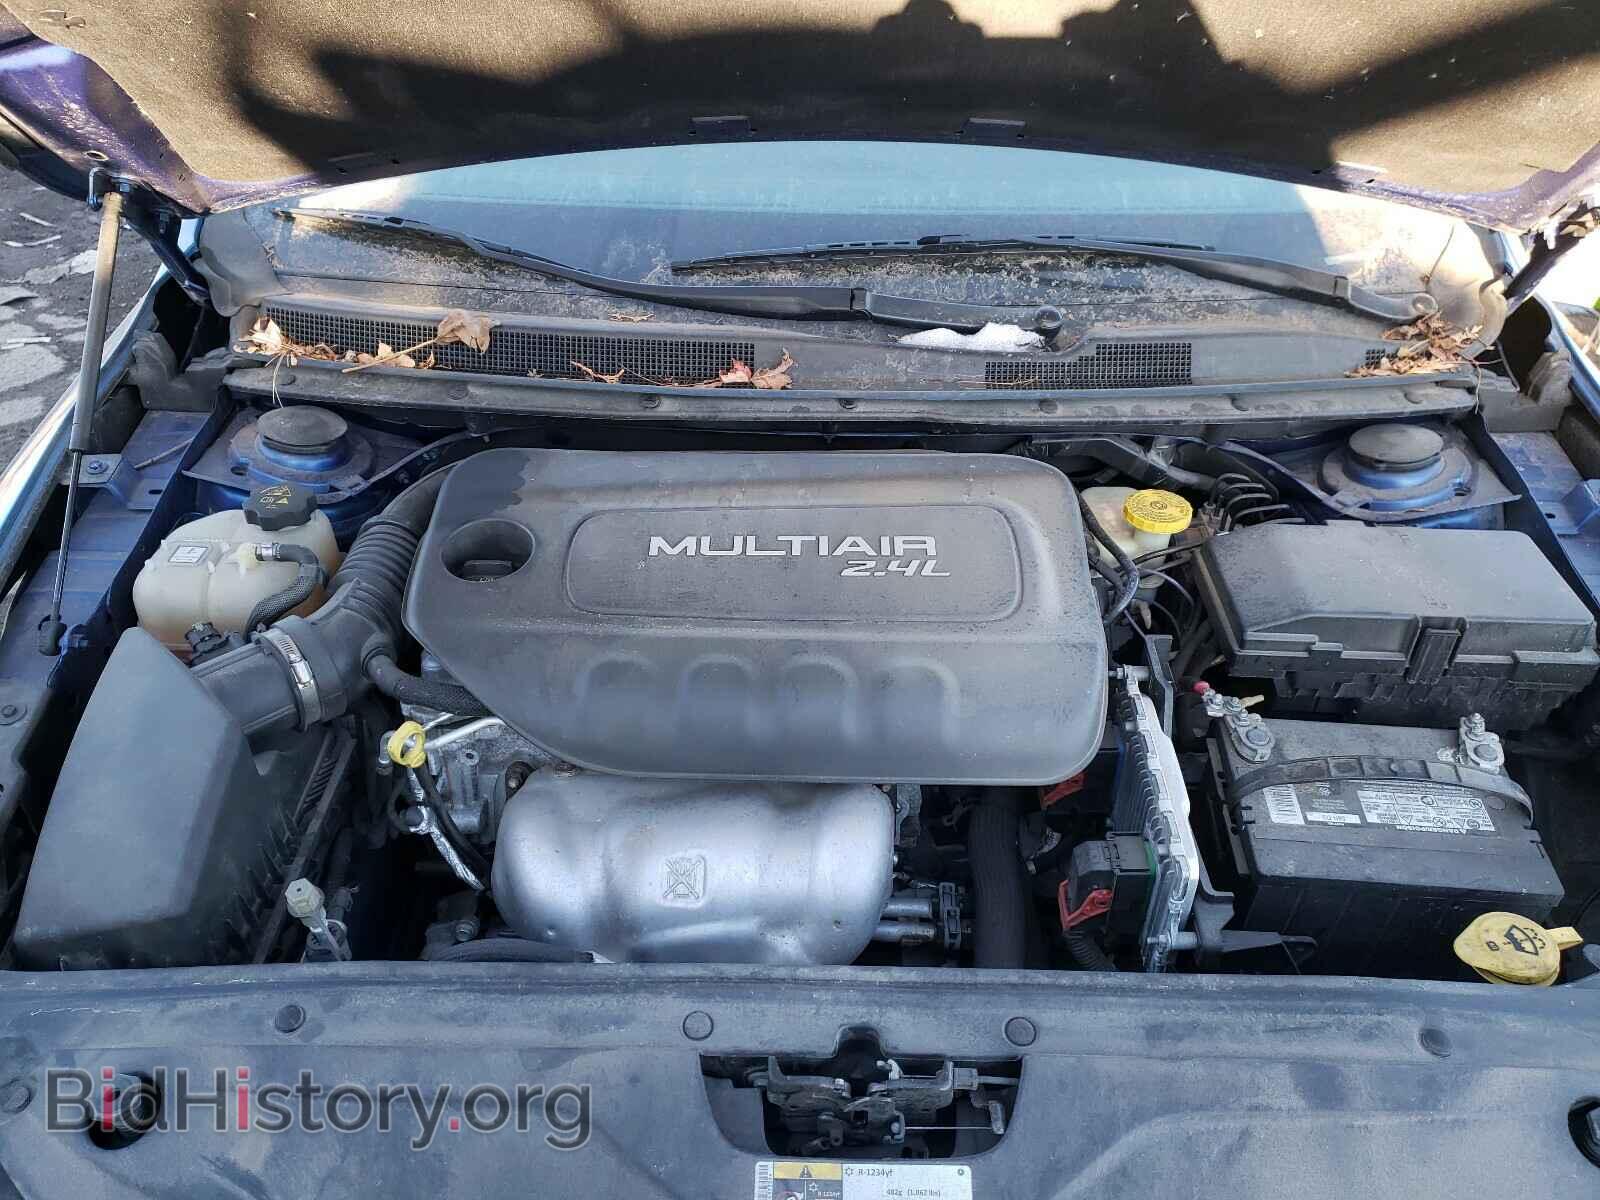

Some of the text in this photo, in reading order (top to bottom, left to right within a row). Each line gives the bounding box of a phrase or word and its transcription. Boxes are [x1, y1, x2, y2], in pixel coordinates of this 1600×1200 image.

[648, 535, 938, 556] MULTIAIR
[840, 559, 950, 577] 2.4L
[857, 1168, 893, 1178] R-1234yf
